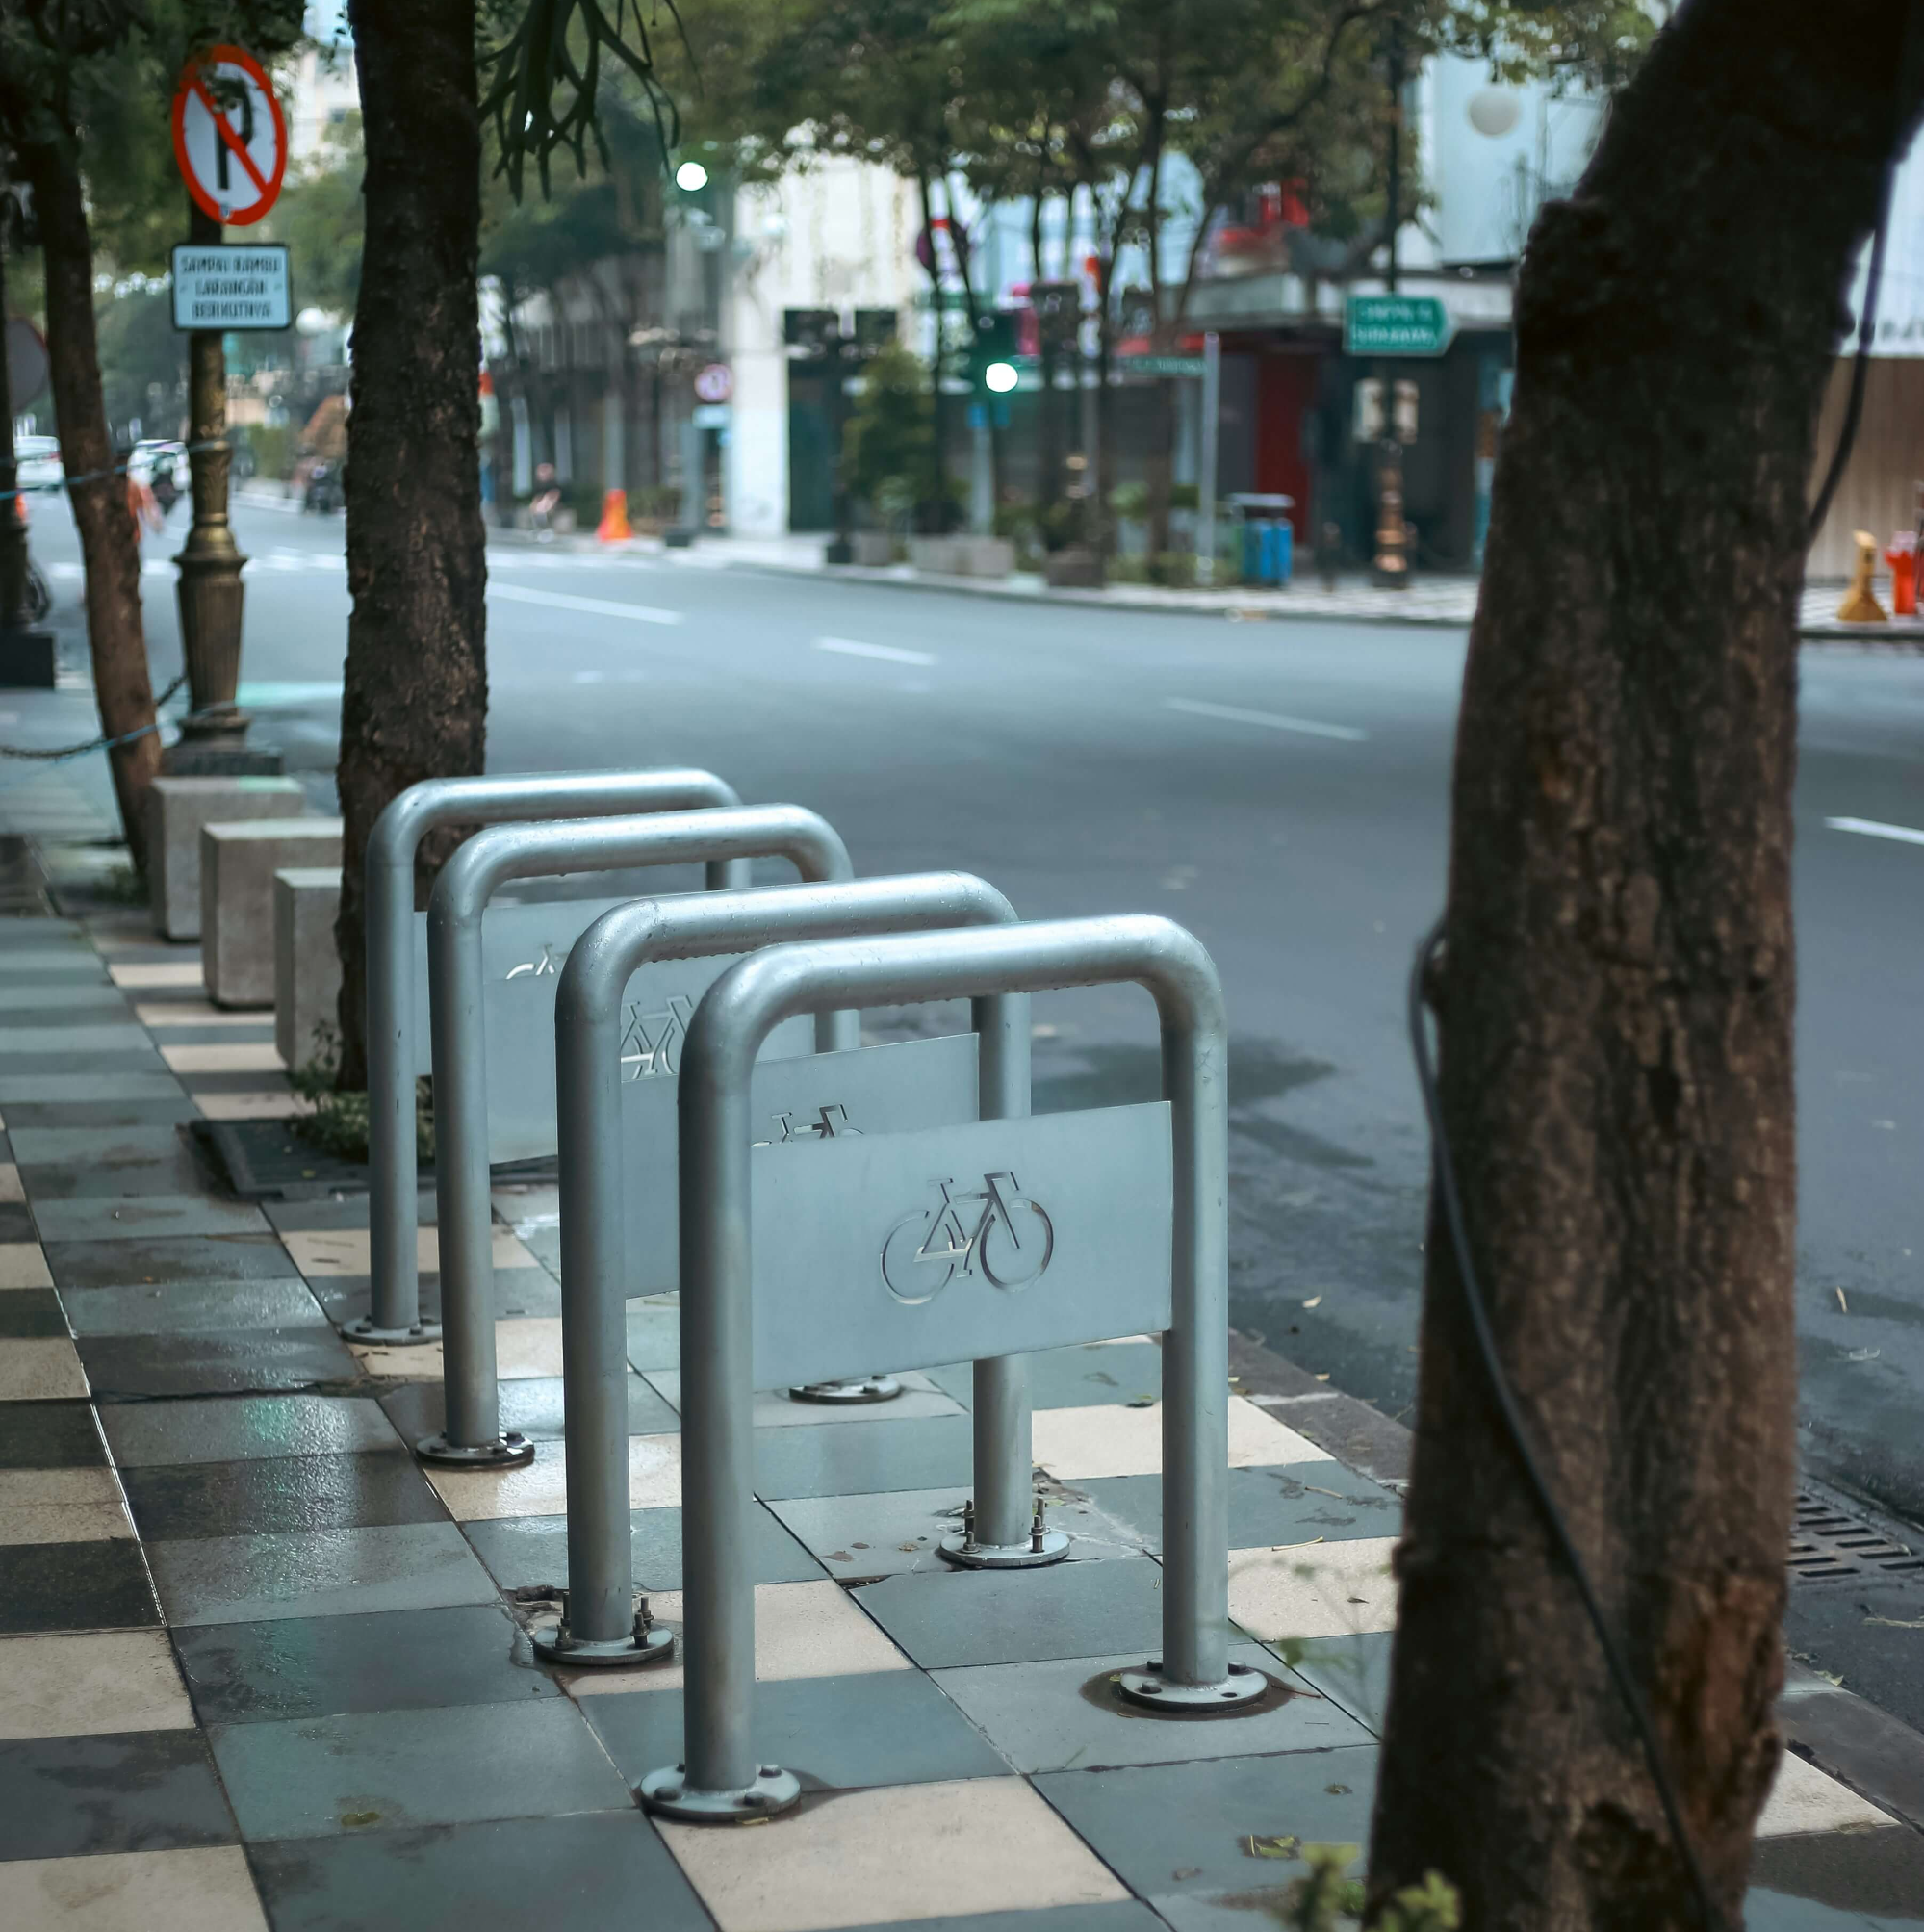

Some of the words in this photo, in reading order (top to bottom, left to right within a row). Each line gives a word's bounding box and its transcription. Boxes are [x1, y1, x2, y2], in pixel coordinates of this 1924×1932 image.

[180, 254, 228, 273] SAMPAI
[232, 254, 280, 273] RAMBU
[194, 277, 267, 296] LARANGAN
[192, 301, 271, 320] BERIKUTNYA
